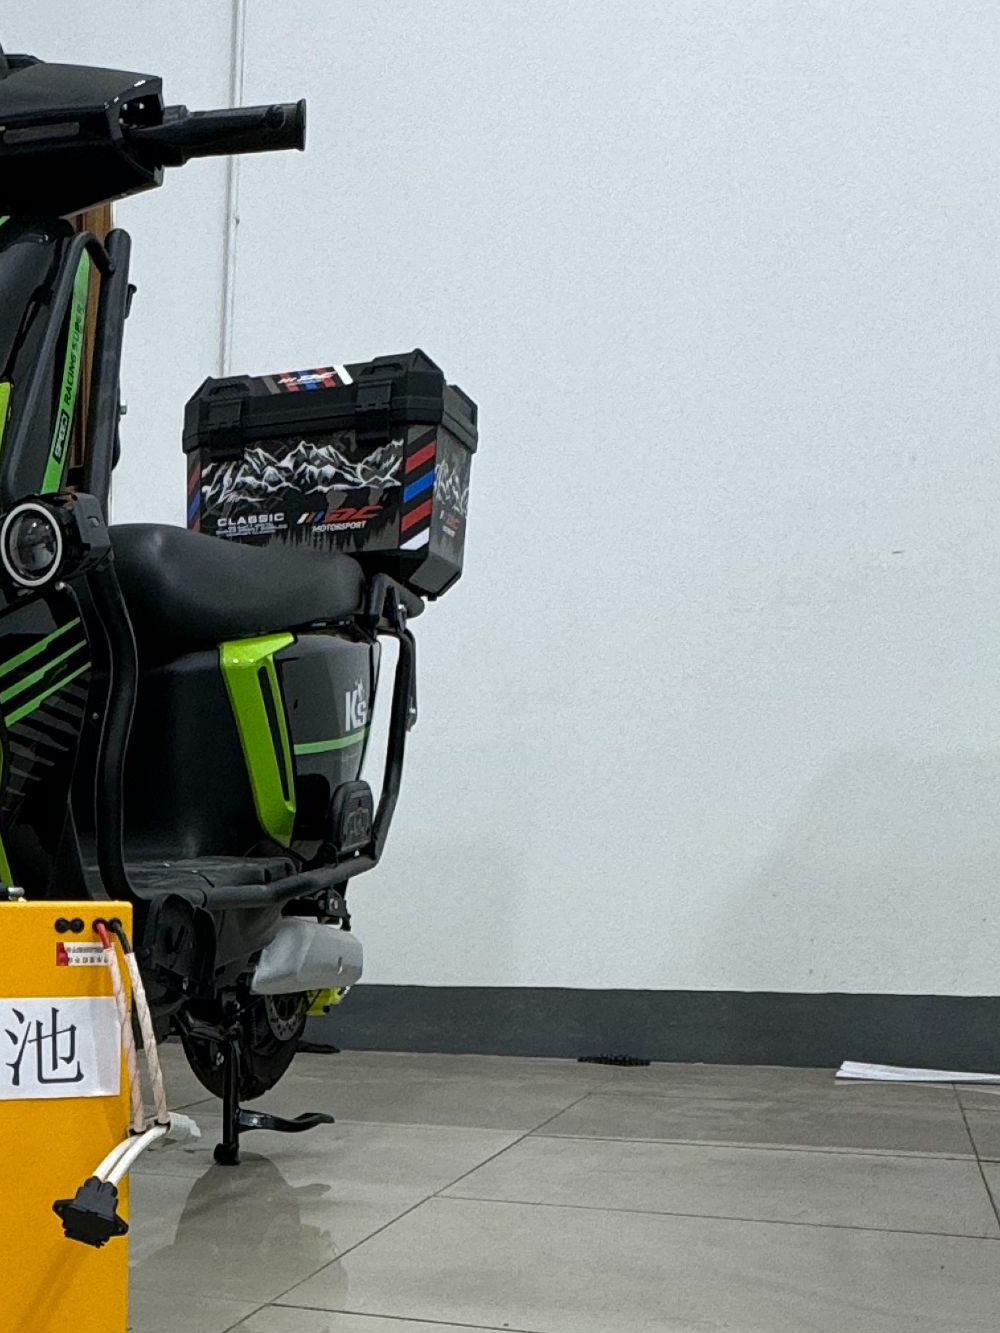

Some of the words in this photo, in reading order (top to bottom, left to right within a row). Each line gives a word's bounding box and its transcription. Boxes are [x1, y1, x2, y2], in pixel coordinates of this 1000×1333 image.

[63, 352, 77, 407] RACING
[217, 512, 285, 527] CLASSIC
[312, 520, 367, 533] MOTORSPORT
